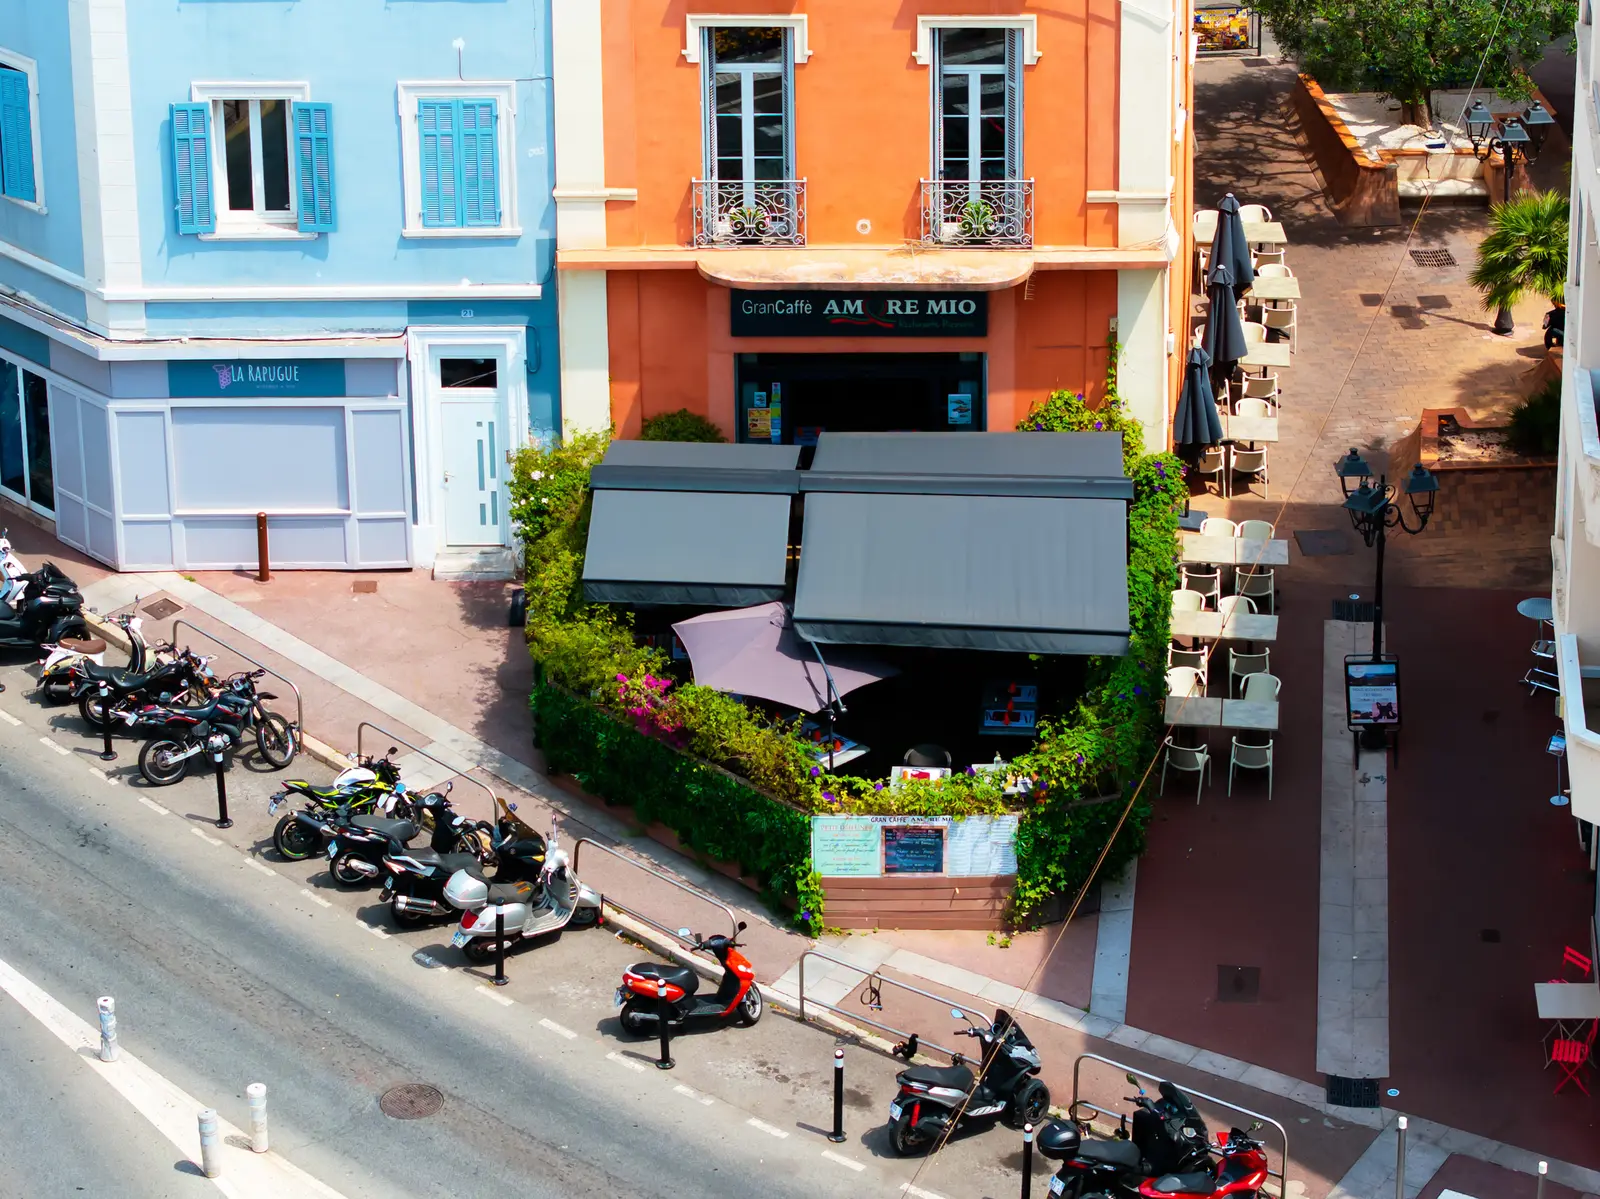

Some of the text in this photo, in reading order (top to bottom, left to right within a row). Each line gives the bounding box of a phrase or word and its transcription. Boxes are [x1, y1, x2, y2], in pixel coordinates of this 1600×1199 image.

[742, 299, 812, 315] GranCaffè
[926, 299, 977, 315] MIO
[231, 364, 300, 382] LA RAPUGUE
